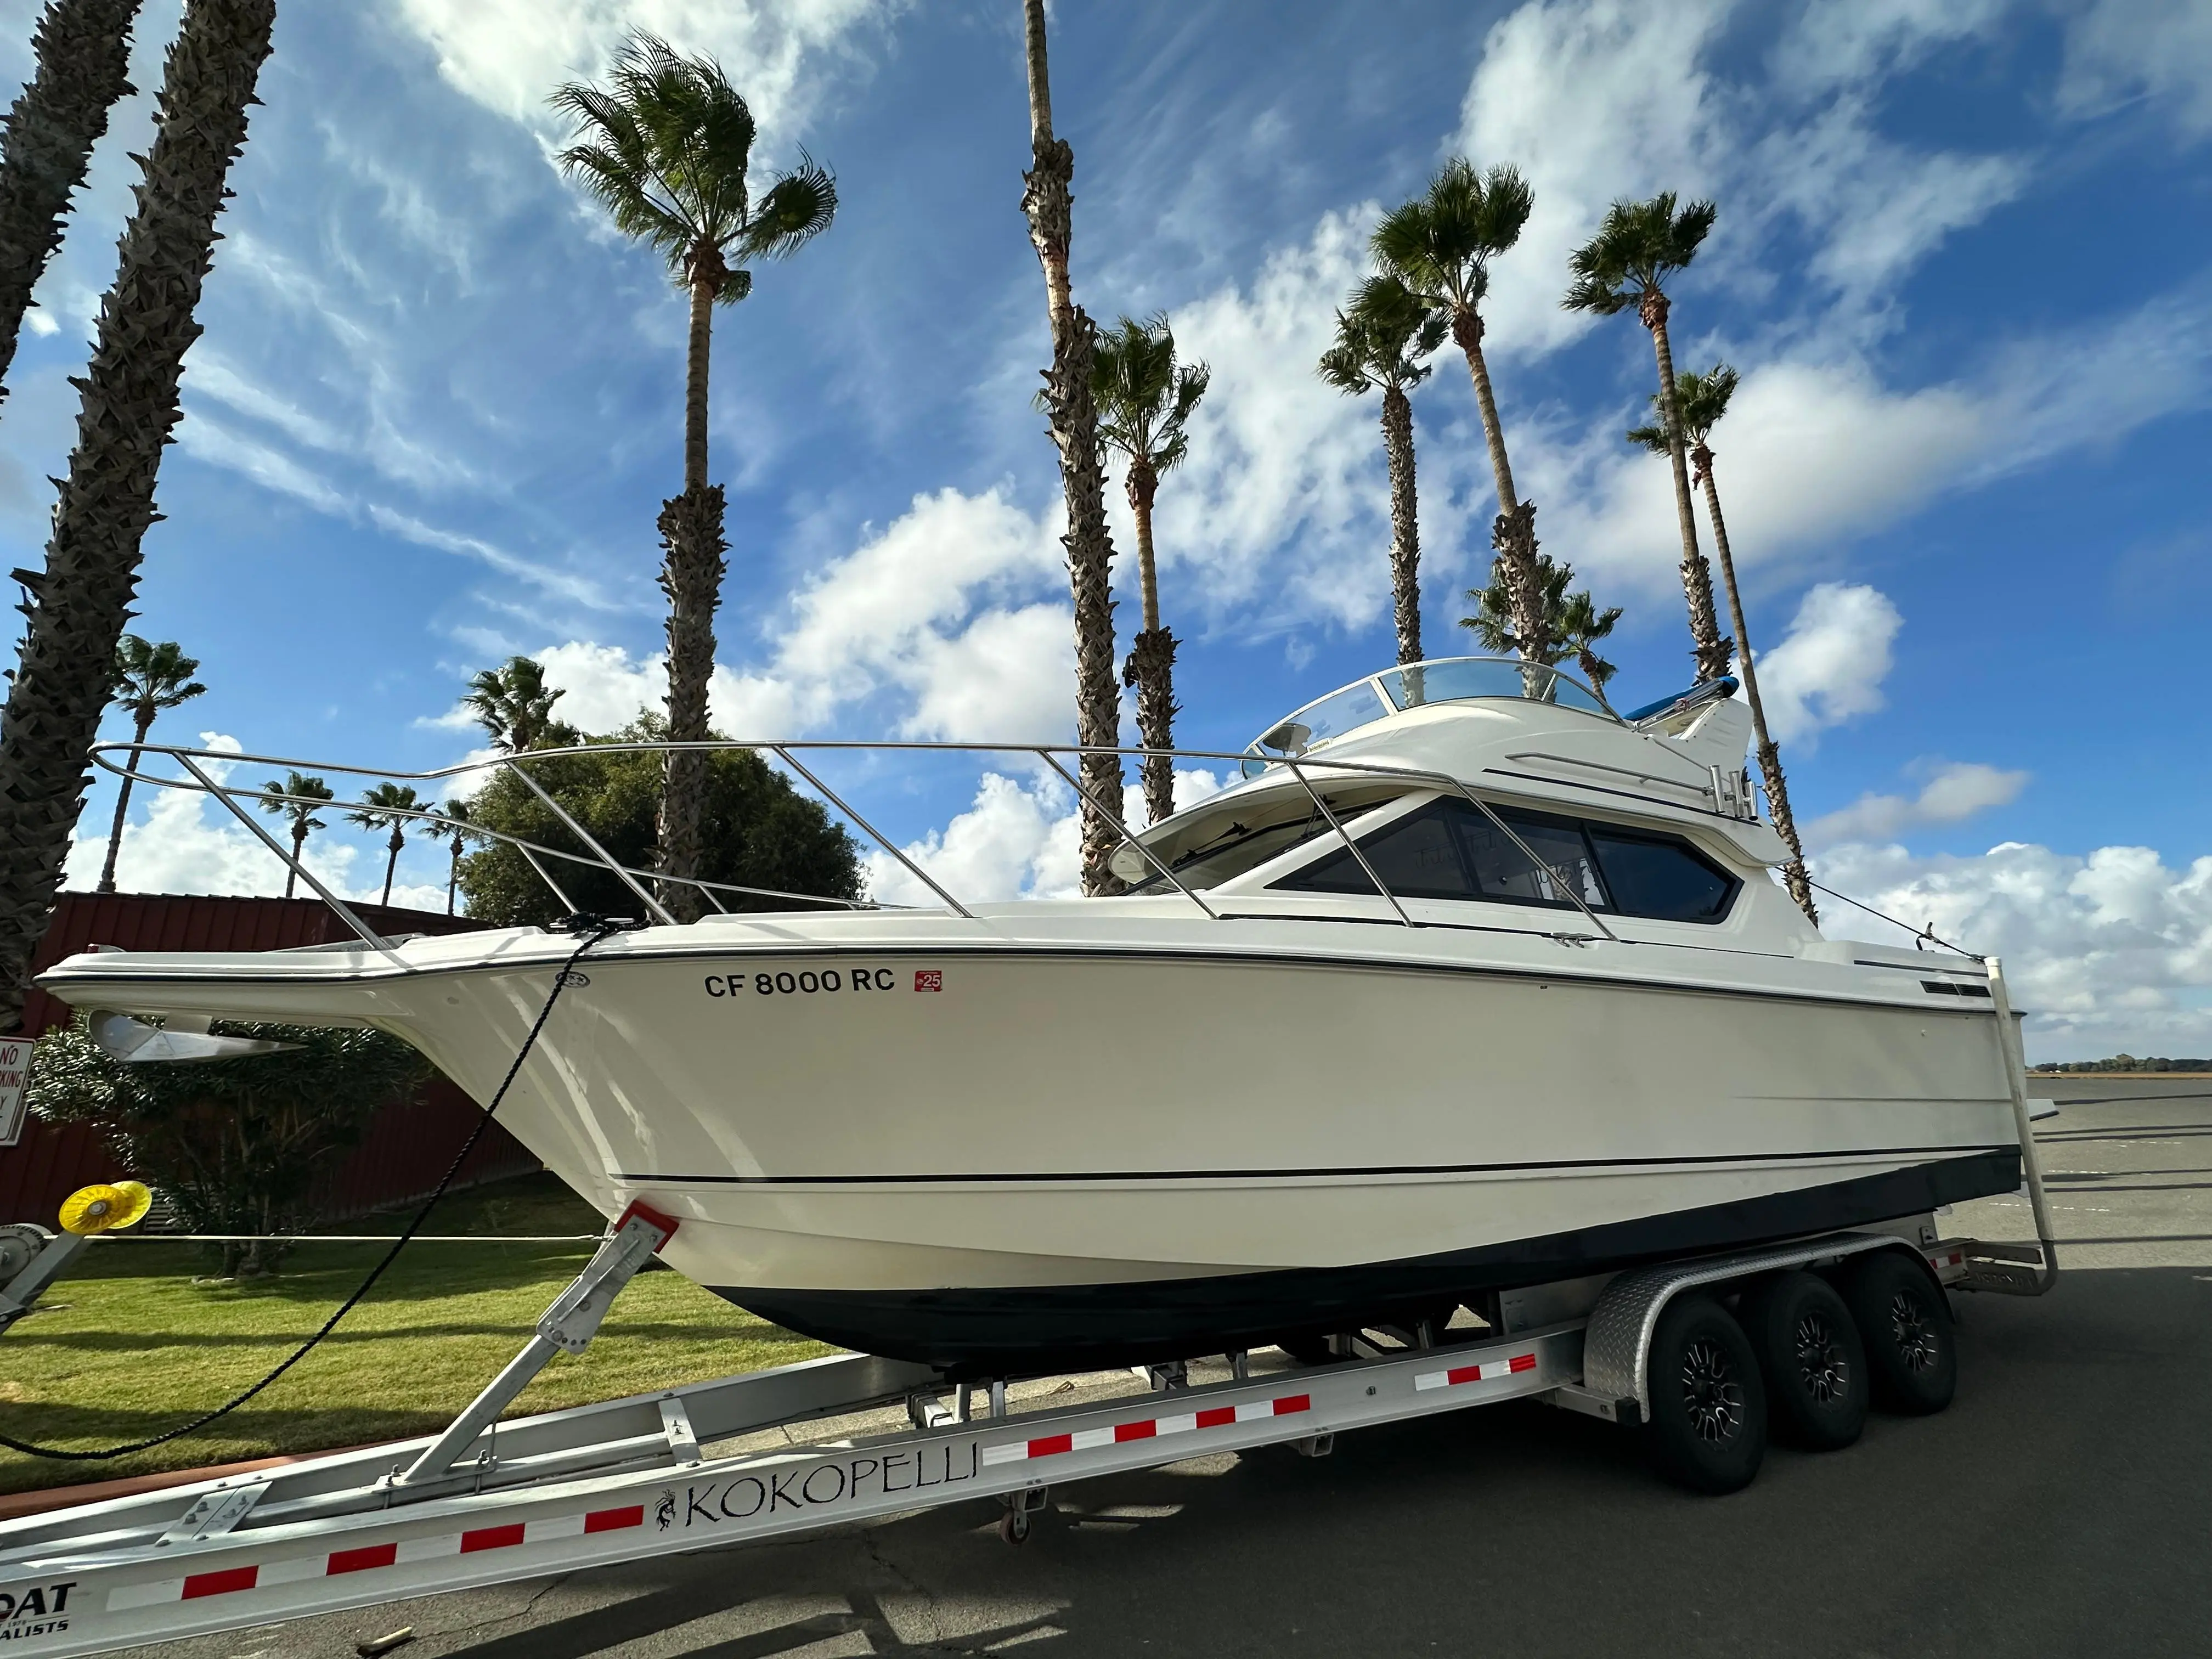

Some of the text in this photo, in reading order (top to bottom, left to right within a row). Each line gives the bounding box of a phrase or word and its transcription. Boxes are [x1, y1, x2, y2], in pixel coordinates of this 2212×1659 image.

[704, 968, 894, 997] CF 8000 RC
[923, 974, 941, 988] 25
[0, 1047, 19, 1065] NO
[686, 1442, 978, 1527] KOKOPELLI
